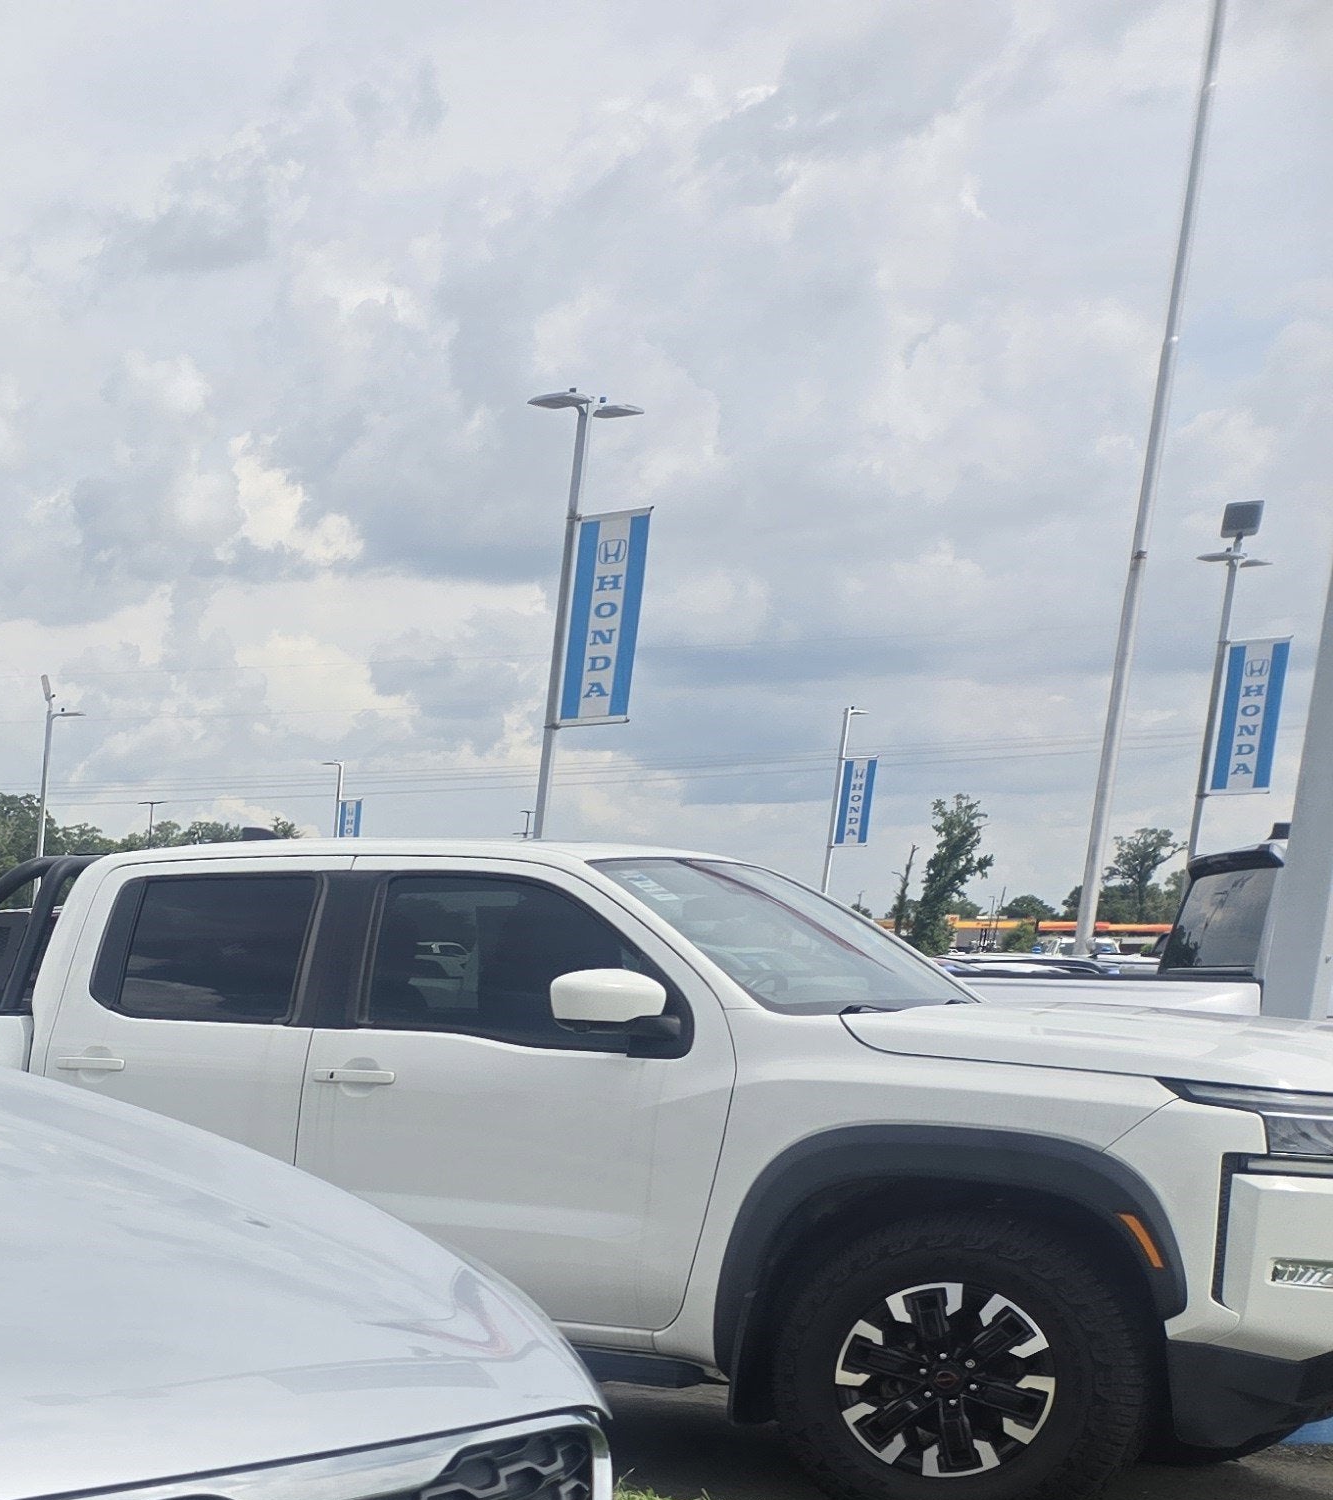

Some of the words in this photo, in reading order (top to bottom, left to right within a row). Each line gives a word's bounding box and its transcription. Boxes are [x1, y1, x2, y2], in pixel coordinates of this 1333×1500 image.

[583, 574, 623, 699] HONDA
[1230, 684, 1268, 775] HONDA
[846, 783, 863, 836] HONDA
